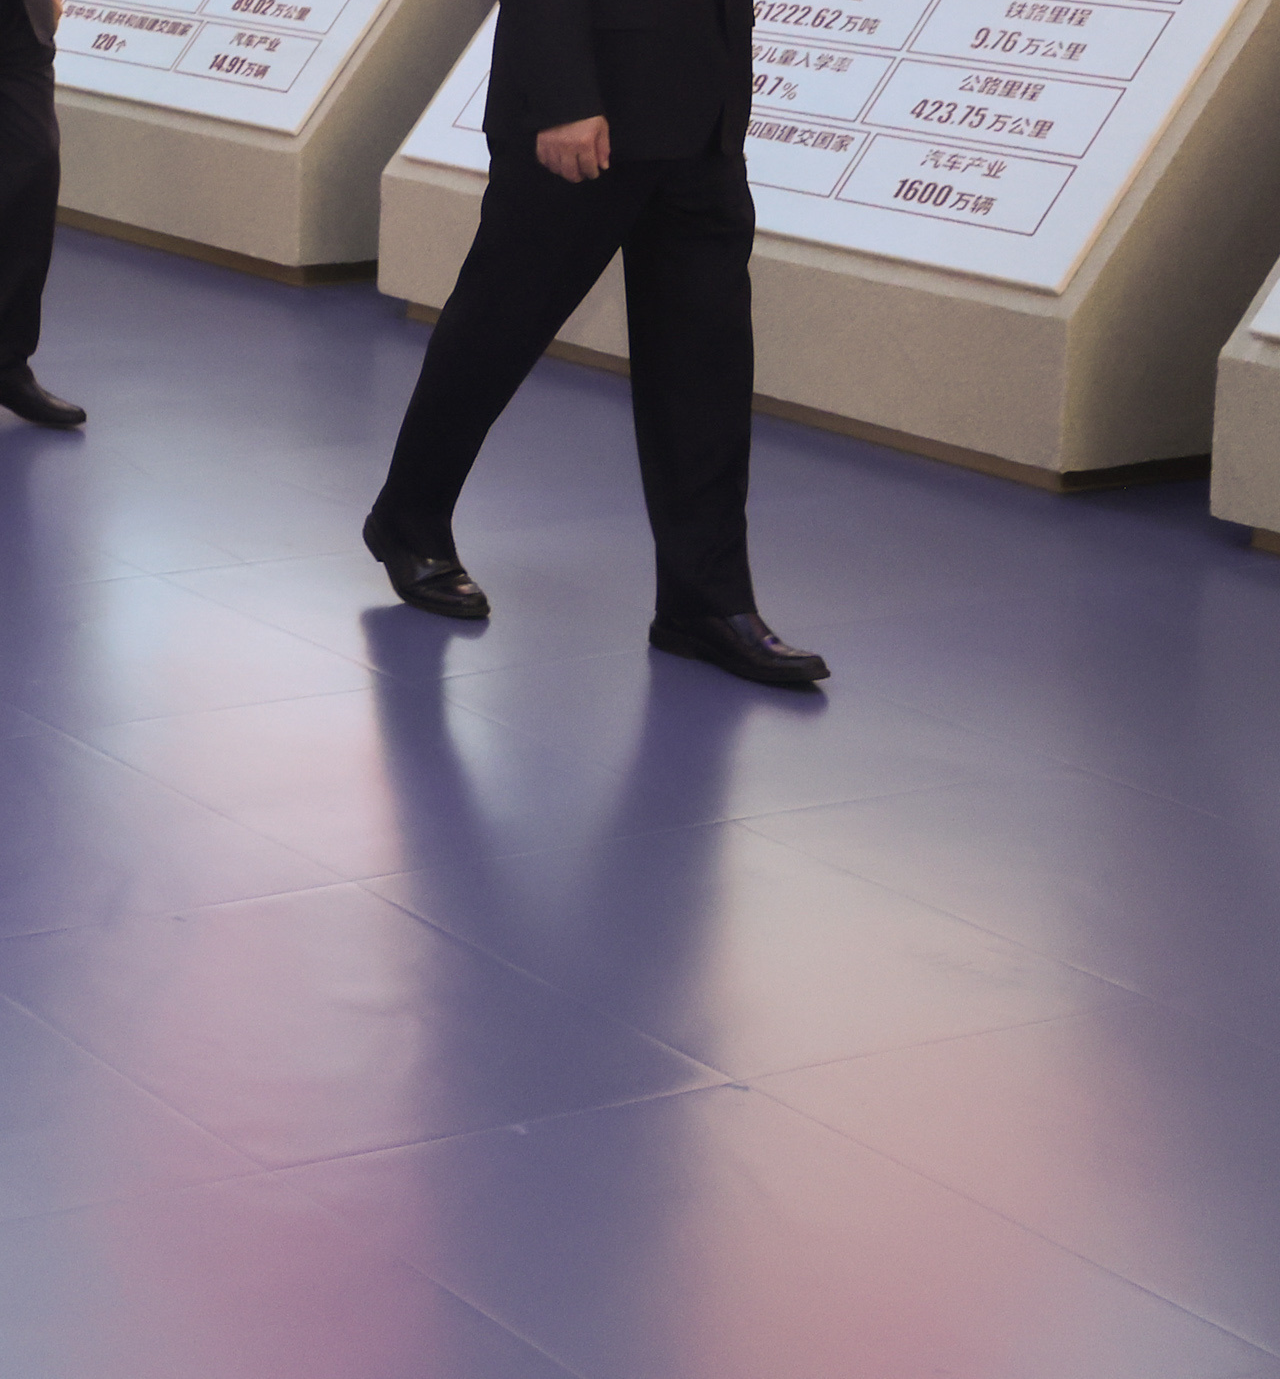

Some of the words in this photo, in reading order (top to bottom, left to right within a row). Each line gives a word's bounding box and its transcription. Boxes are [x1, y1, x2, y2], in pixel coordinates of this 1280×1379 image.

[1004, 0, 1094, 27] 铁路里程
[752, 73, 800, 101] 9.7%
[958, 74, 1046, 102] 公路里程
[919, 148, 1008, 180] 汽车产业
